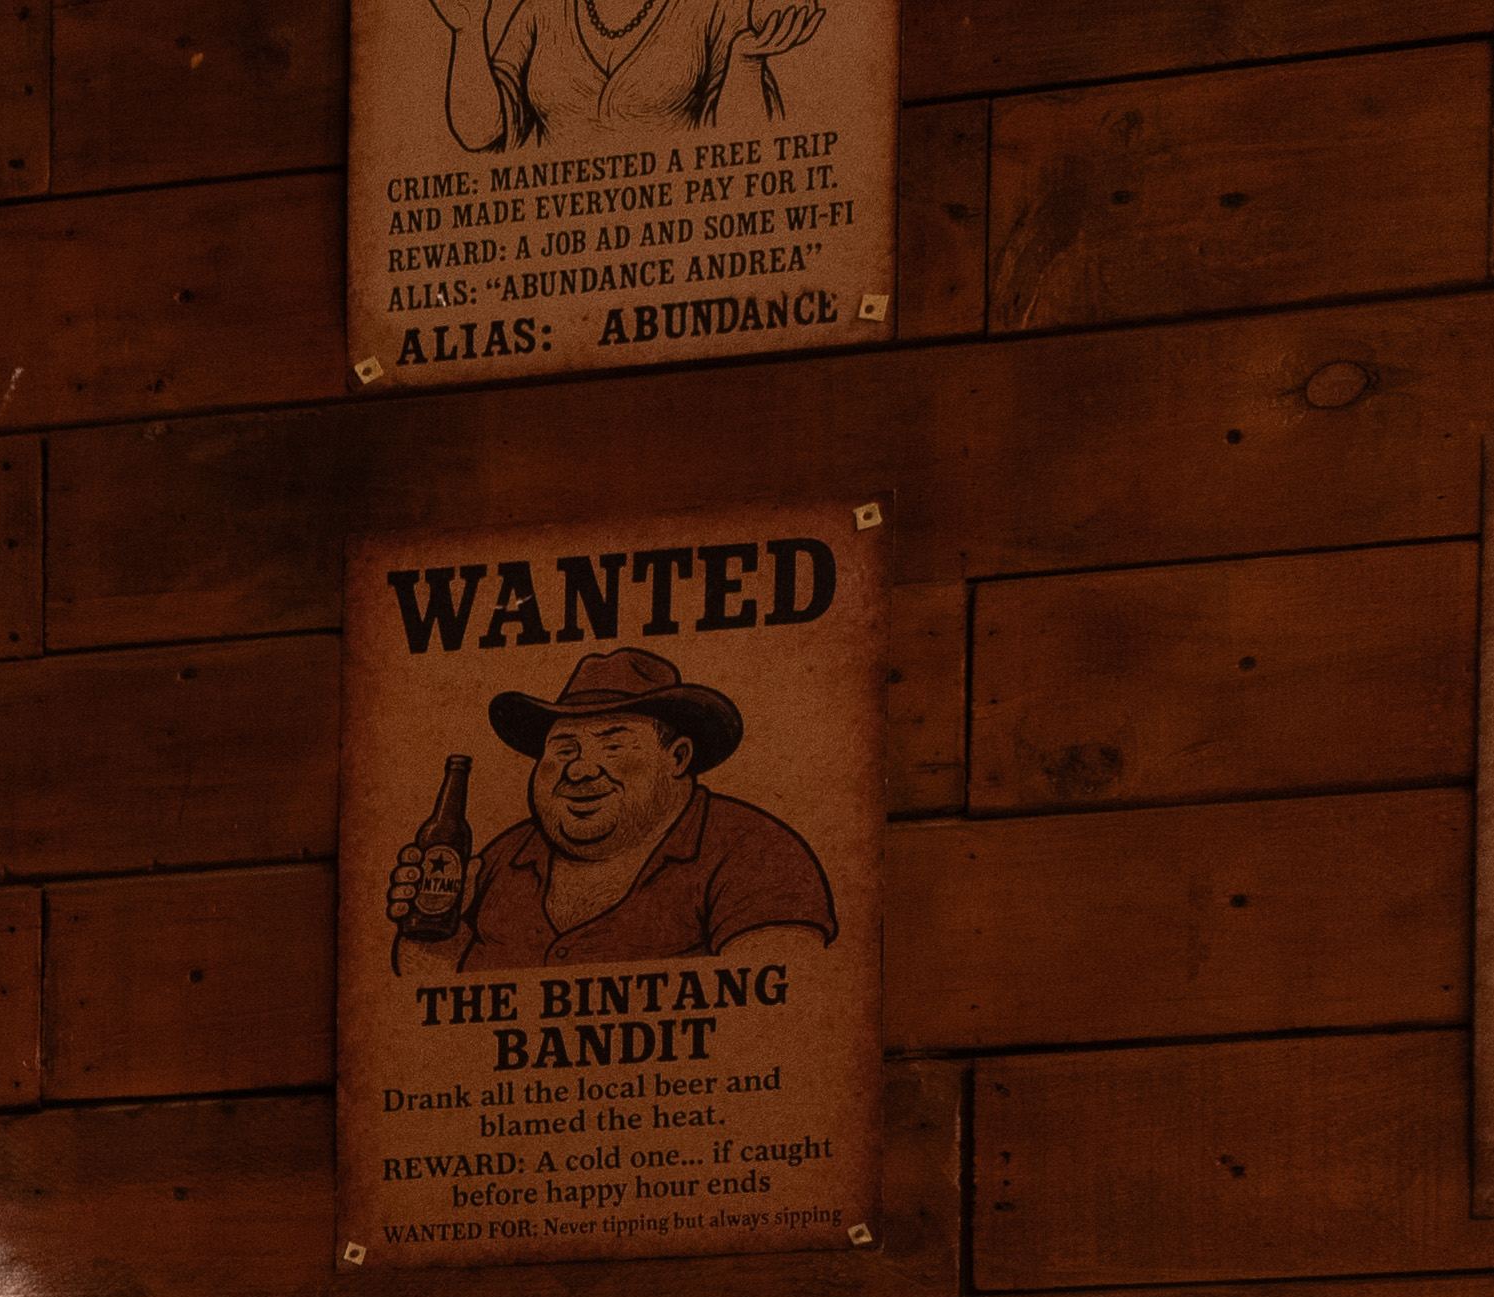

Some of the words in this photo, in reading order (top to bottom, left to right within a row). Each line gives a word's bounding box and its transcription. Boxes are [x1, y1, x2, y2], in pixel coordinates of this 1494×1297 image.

[388, 172, 478, 202] CRIME:
[491, 152, 656, 192] MANIFESTED
[667, 149, 683, 173] A
[695, 140, 761, 170] FREE
[774, 132, 838, 160] TRIP
[389, 208, 441, 235] AND
[453, 199, 525, 228] MADE
[536, 183, 672, 219] EVERYONE
[685, 176, 734, 204] PAY
[745, 170, 796, 197] FOR
[806, 165, 837, 191] IT.
[388, 240, 505, 272] REWARD:
[515, 236, 531, 260] A
[541, 230, 586, 257] JOB
[596, 226, 630, 251] AD
[640, 219, 693, 246] AND
[705, 210, 774, 240] SOME
[785, 201, 853, 231] WI-FI
[388, 280, 476, 312] ALIAS:
[487, 259, 674, 301] "ABUNDANCE
[686, 243, 822, 282] ANDREA"
[396, 318, 551, 366] ALIAS:
[598, 290, 837, 346] ABUNDANCE
[387, 537, 836, 654] WANTED
[416, 983, 517, 1026] THE
[540, 965, 788, 1019] BINTANG
[493, 1017, 716, 1071] BANDIT
[383, 1085, 471, 1112] Drank
[481, 1082, 514, 1106] all
[524, 1080, 568, 1104] the
[578, 1074, 645, 1101] local
[655, 1073, 717, 1096] beer
[726, 1066, 781, 1092] and
[480, 1109, 585, 1137] blamed
[597, 1107, 641, 1131] the
[652, 1105, 725, 1128] heat.
[383, 1153, 524, 1181] REWARD:
[535, 1151, 558, 1173] A
[566, 1145, 621, 1171] cold
[630, 1150, 703, 1168] one...
[713, 1140, 733, 1163] if
[741, 1136, 833, 1166] caught
[453, 1183, 537, 1207] before
[546, 1180, 627, 1209] happy
[636, 1176, 699, 1198] hour
[707, 1169, 770, 1195] ends
[382, 1221, 482, 1249] WANTED
[489, 1219, 537, 1239] FOR:
[544, 1218, 597, 1236] Never
[603, 1214, 669, 1241] tipping
[674, 1212, 704, 1229] but
[709, 1210, 772, 1232] always
[774, 1206, 844, 1230] sipping
